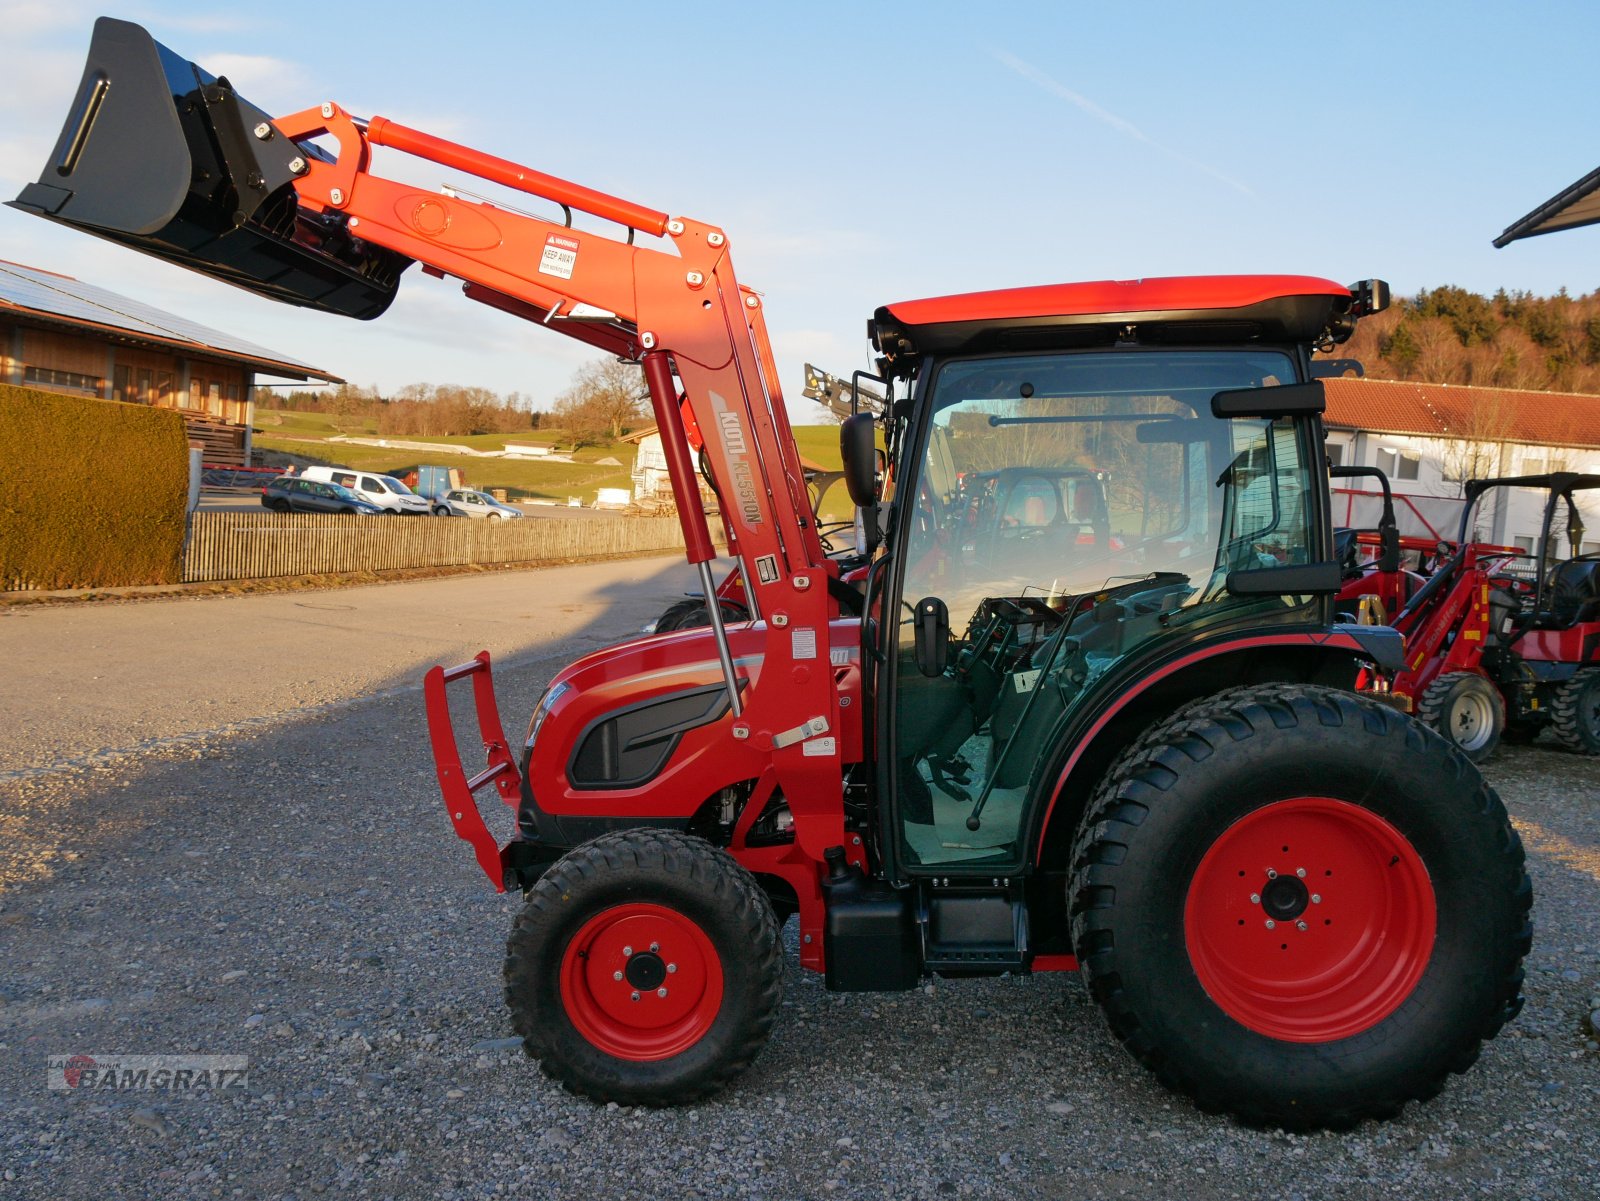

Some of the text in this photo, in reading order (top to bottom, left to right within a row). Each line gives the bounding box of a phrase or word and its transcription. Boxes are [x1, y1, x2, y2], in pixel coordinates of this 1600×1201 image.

[555, 237, 578, 249] WARNING
[543, 249, 575, 264] KEEP AWAY
[719, 411, 763, 524] KIOTI KL5510N
